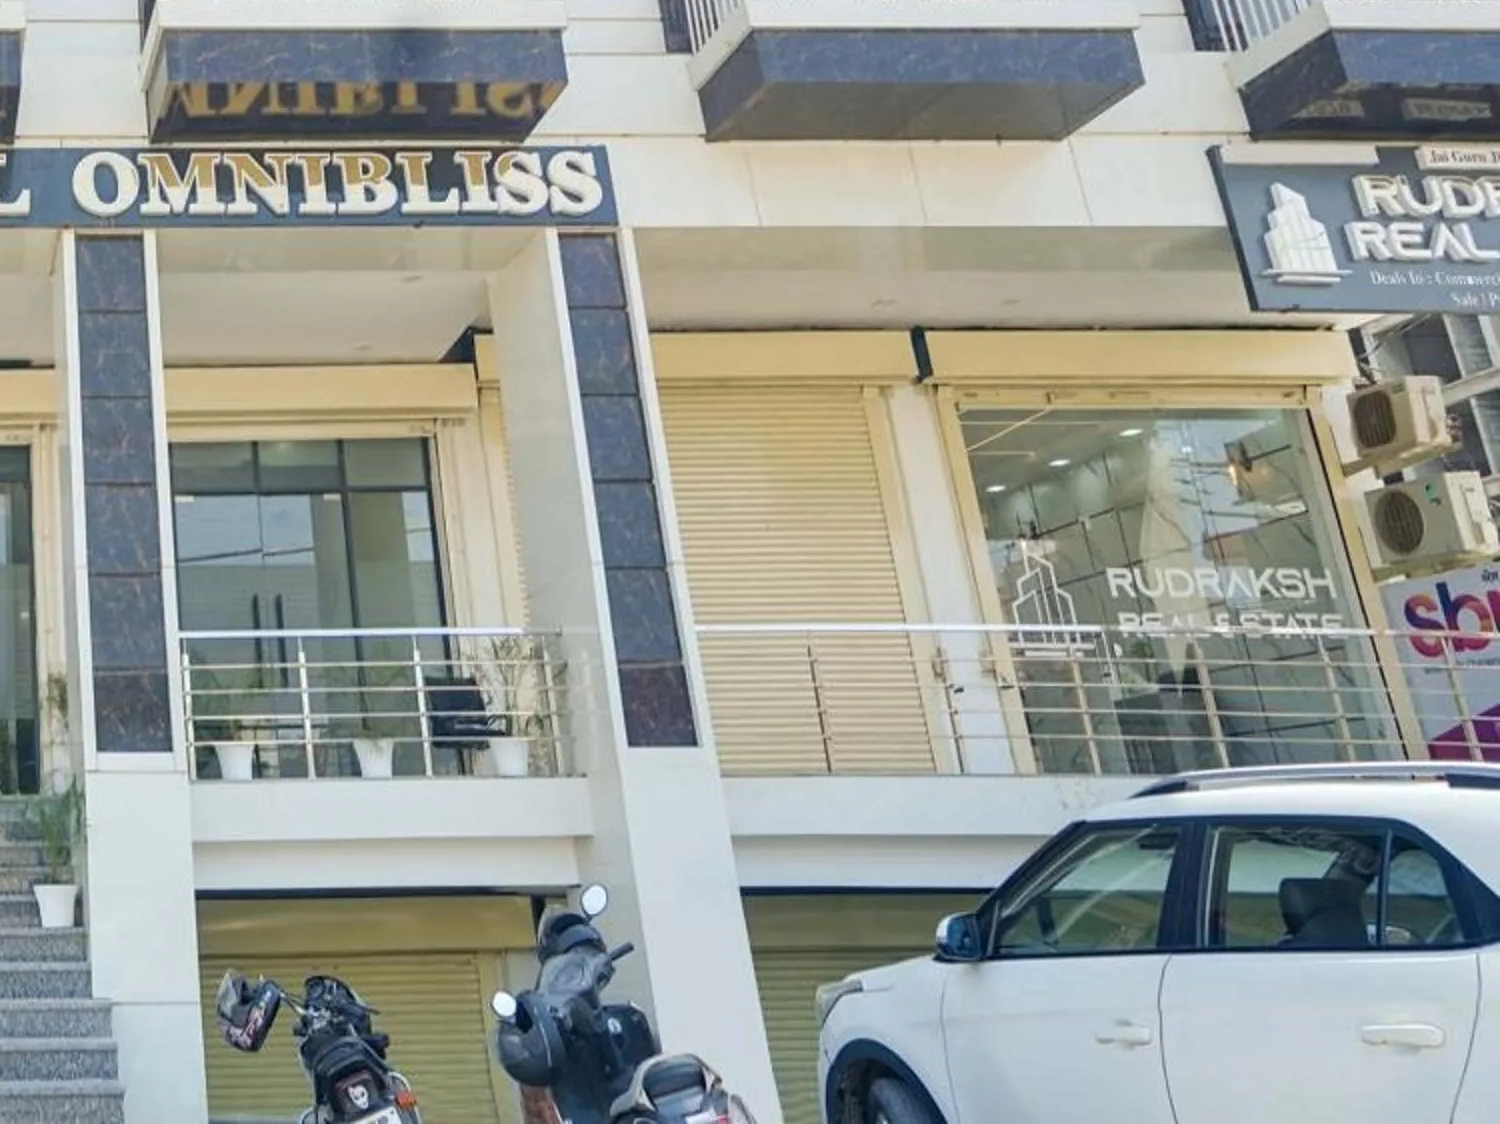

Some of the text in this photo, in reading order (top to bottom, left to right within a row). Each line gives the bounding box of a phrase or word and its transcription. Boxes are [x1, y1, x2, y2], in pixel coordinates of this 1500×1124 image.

[72, 151, 603, 218] OMNIBLISS
[1344, 221, 1500, 262] REAL
[1106, 566, 1337, 599] RUDRAKSH
